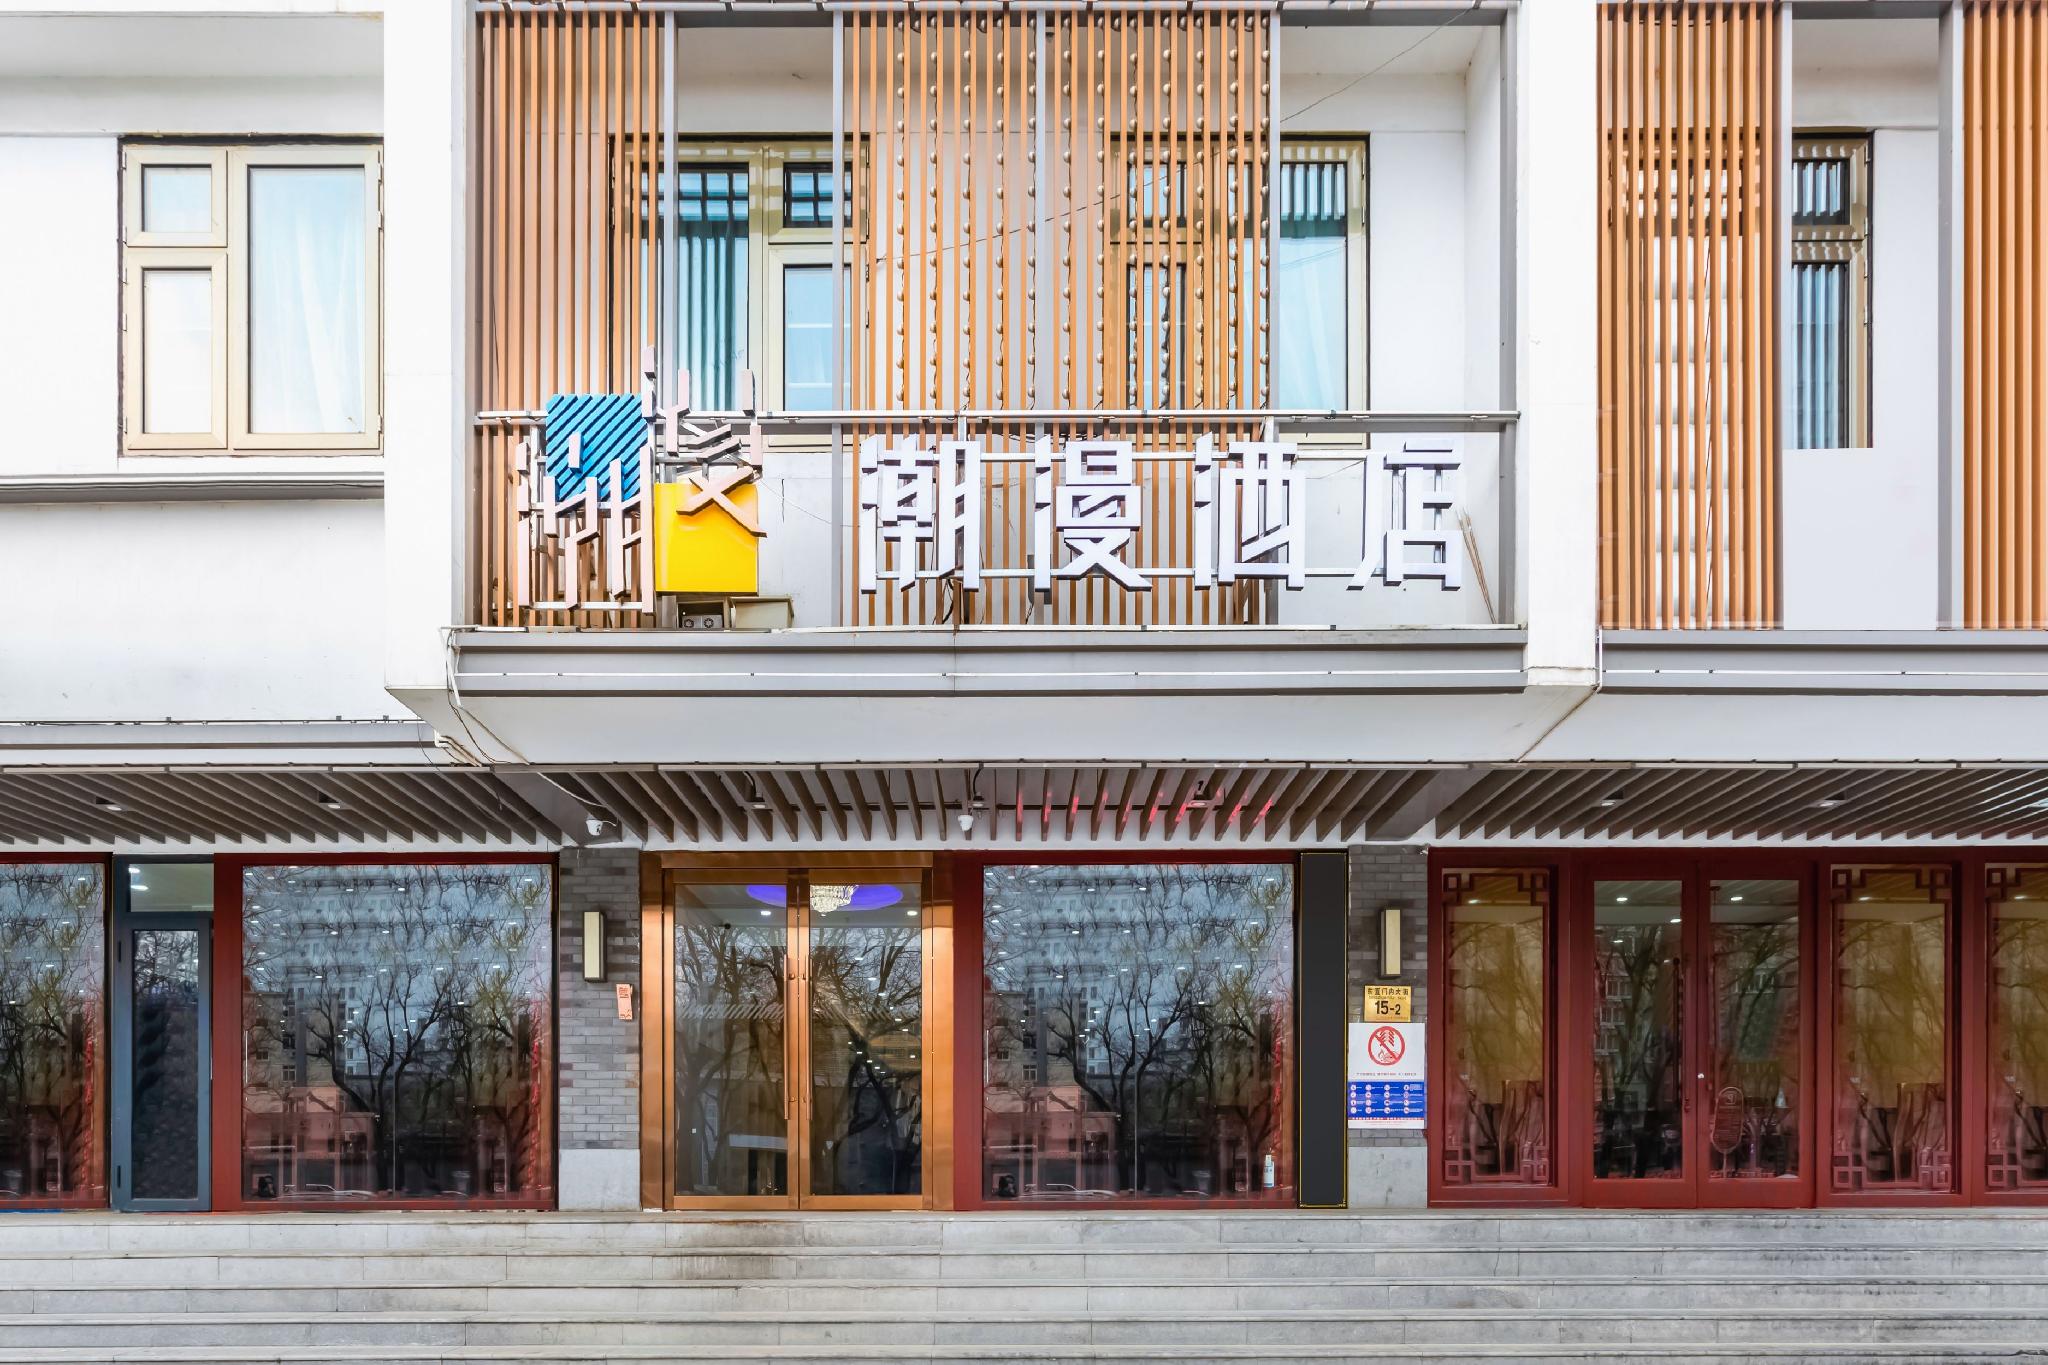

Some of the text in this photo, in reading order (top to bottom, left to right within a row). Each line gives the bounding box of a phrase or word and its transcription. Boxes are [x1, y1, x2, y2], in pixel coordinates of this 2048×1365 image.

[860, 431, 1462, 592] 潮漫酒店
[1375, 1000, 1401, 1015] 15-2
